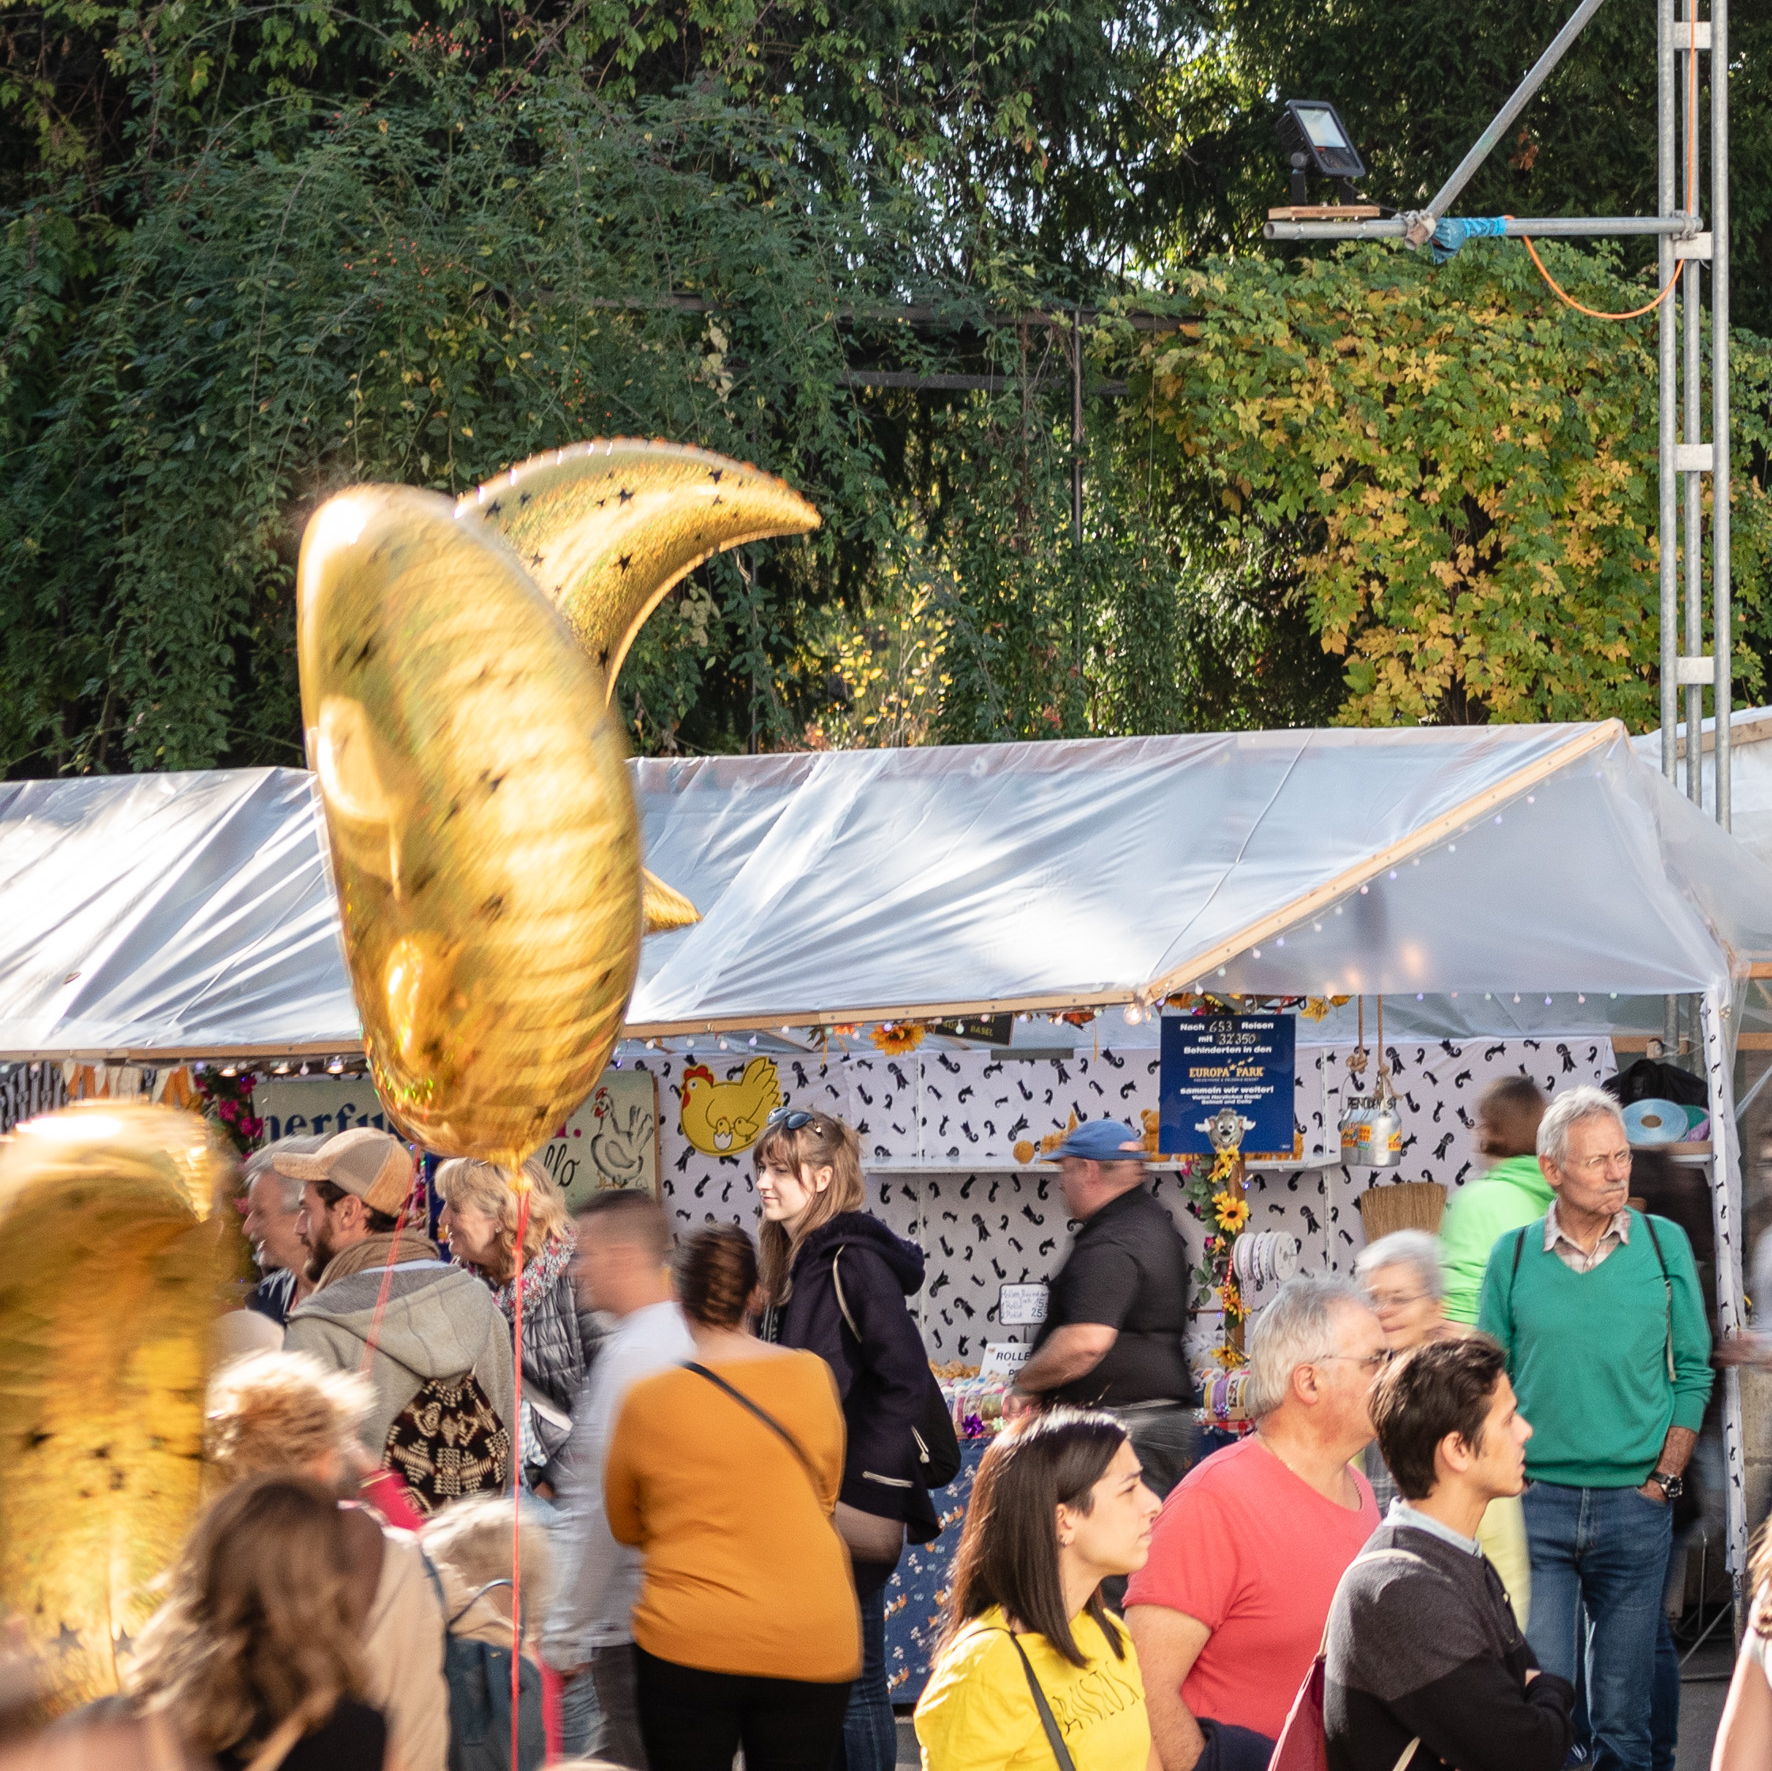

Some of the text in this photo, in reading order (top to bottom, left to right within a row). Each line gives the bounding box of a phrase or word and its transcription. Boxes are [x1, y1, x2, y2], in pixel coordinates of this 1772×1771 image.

[1180, 1022, 1205, 1031] Nach
[1208, 1020, 1233, 1033] 653
[1198, 1034, 1213, 1043] mit
[1183, 1046, 1241, 1055] Behinderten
[1188, 1066, 1264, 1078] EUROPA PARK
[1180, 1086, 1221, 1095] sammeln
[1223, 1085, 1239, 1094] wir
